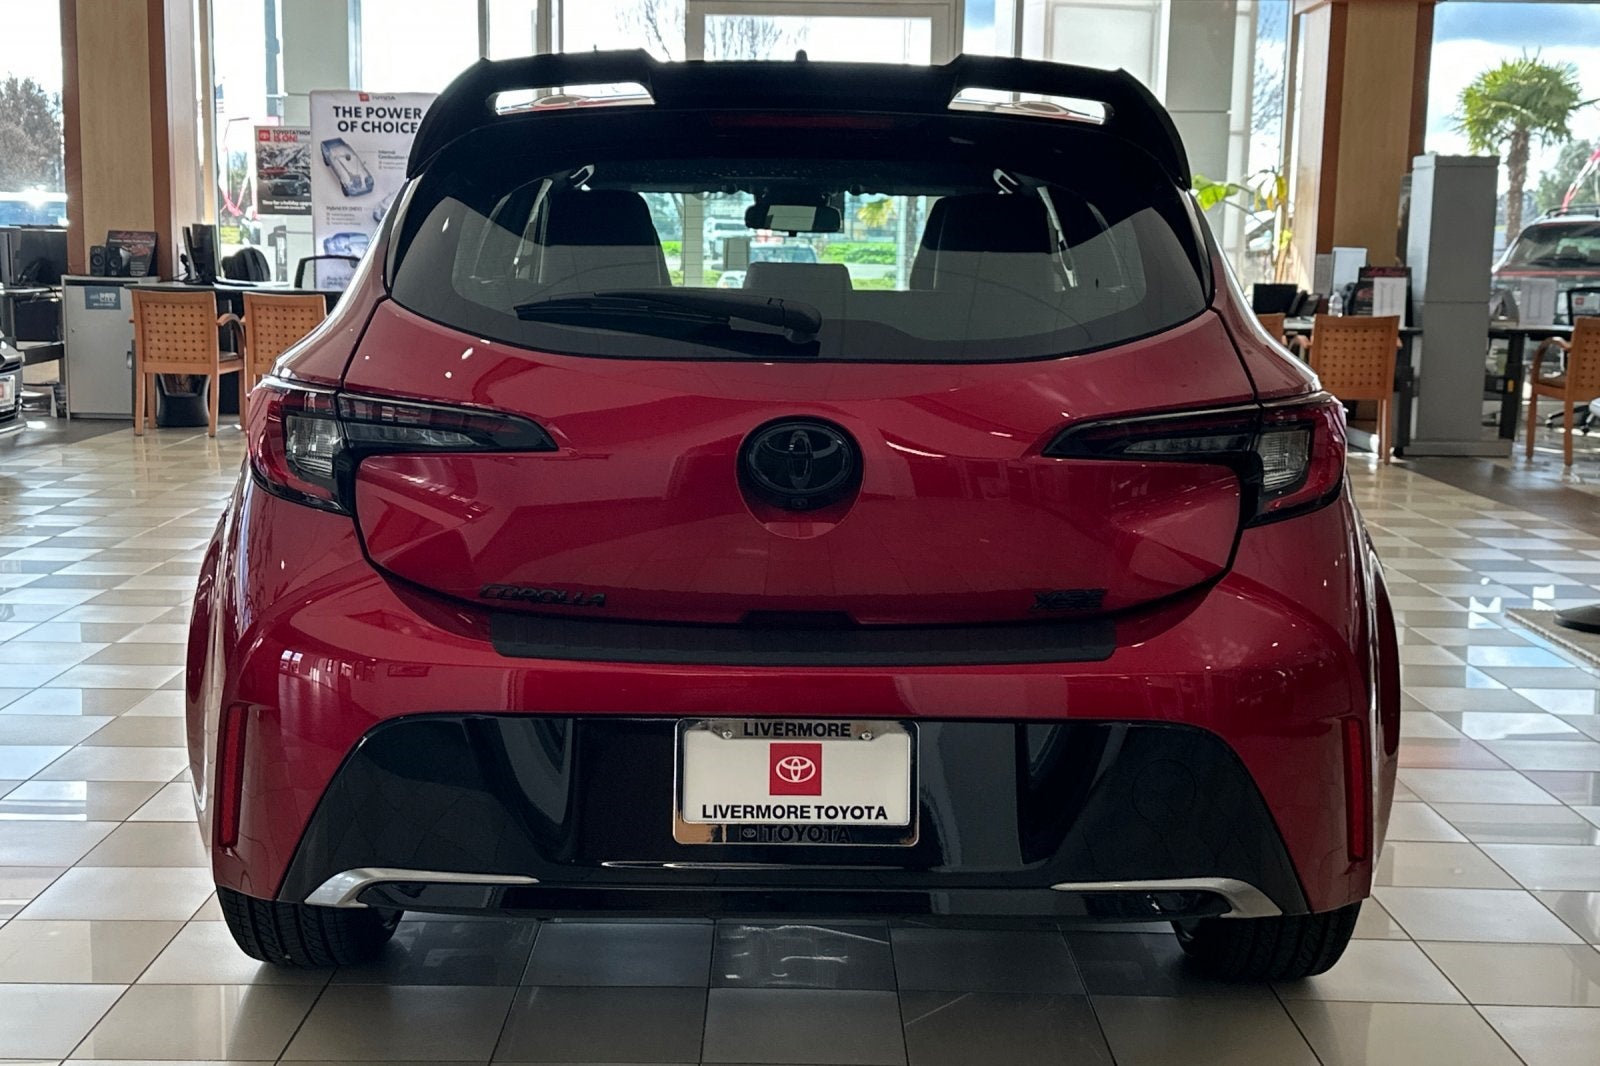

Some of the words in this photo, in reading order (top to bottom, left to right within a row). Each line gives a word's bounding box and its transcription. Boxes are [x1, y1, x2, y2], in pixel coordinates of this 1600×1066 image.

[333, 106, 362, 118] THE
[366, 107, 422, 119] POWER
[338, 121, 358, 133] OF
[361, 121, 418, 134] CHOICE
[479, 583, 606, 608] COROLLA
[743, 723, 851, 737] LIVERMORE
[702, 805, 811, 819] LIVERMORE
[814, 806, 888, 820] TOYOTA
[764, 825, 852, 842] TOYOTA
